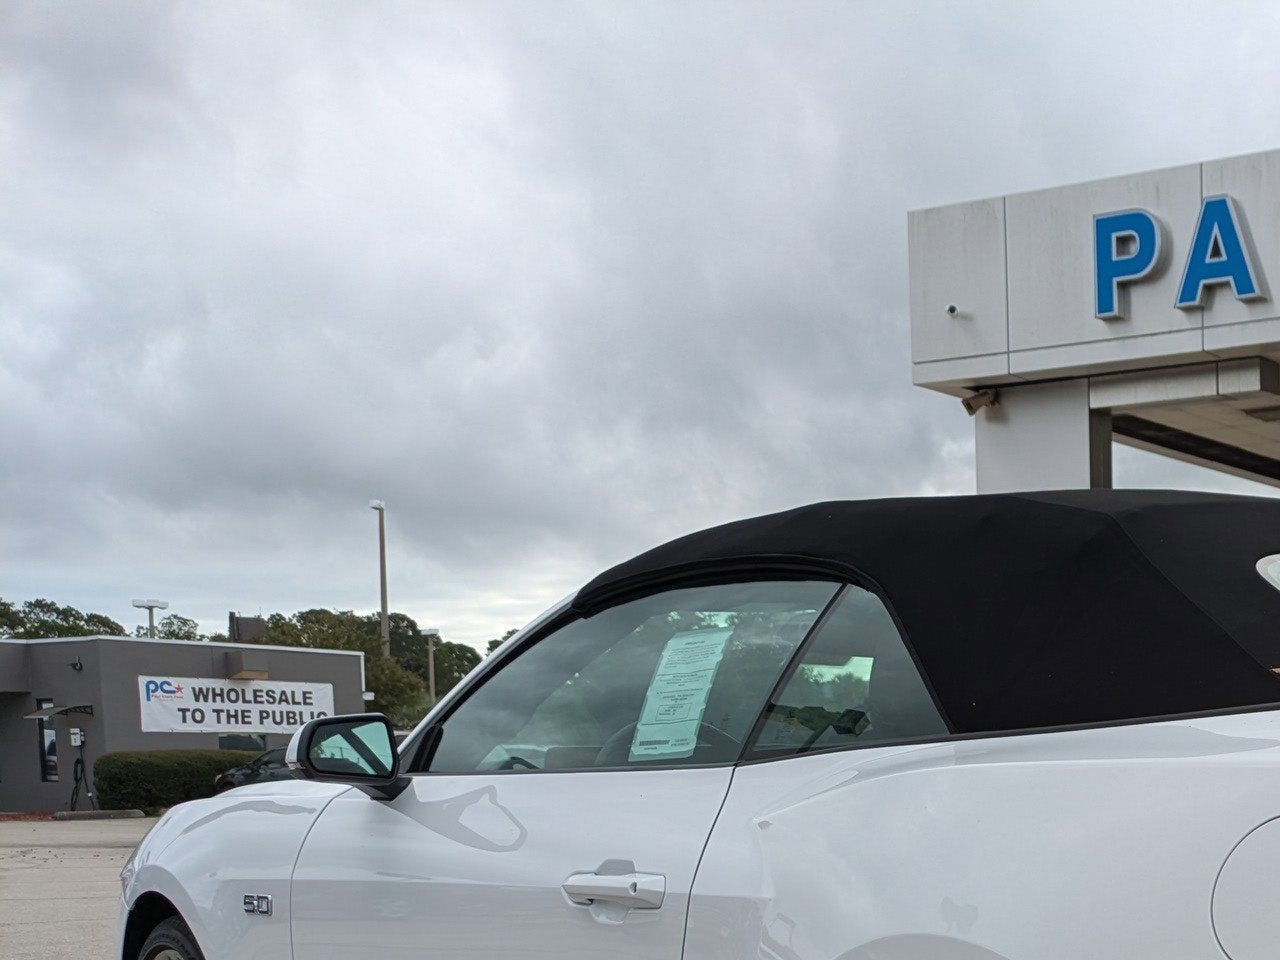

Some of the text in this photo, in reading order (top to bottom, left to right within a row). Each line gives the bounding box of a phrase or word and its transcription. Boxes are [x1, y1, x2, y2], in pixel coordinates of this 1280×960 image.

[191, 687, 314, 705] WHOLESALE
[177, 708, 205, 724] TO
[212, 709, 252, 725] THE
